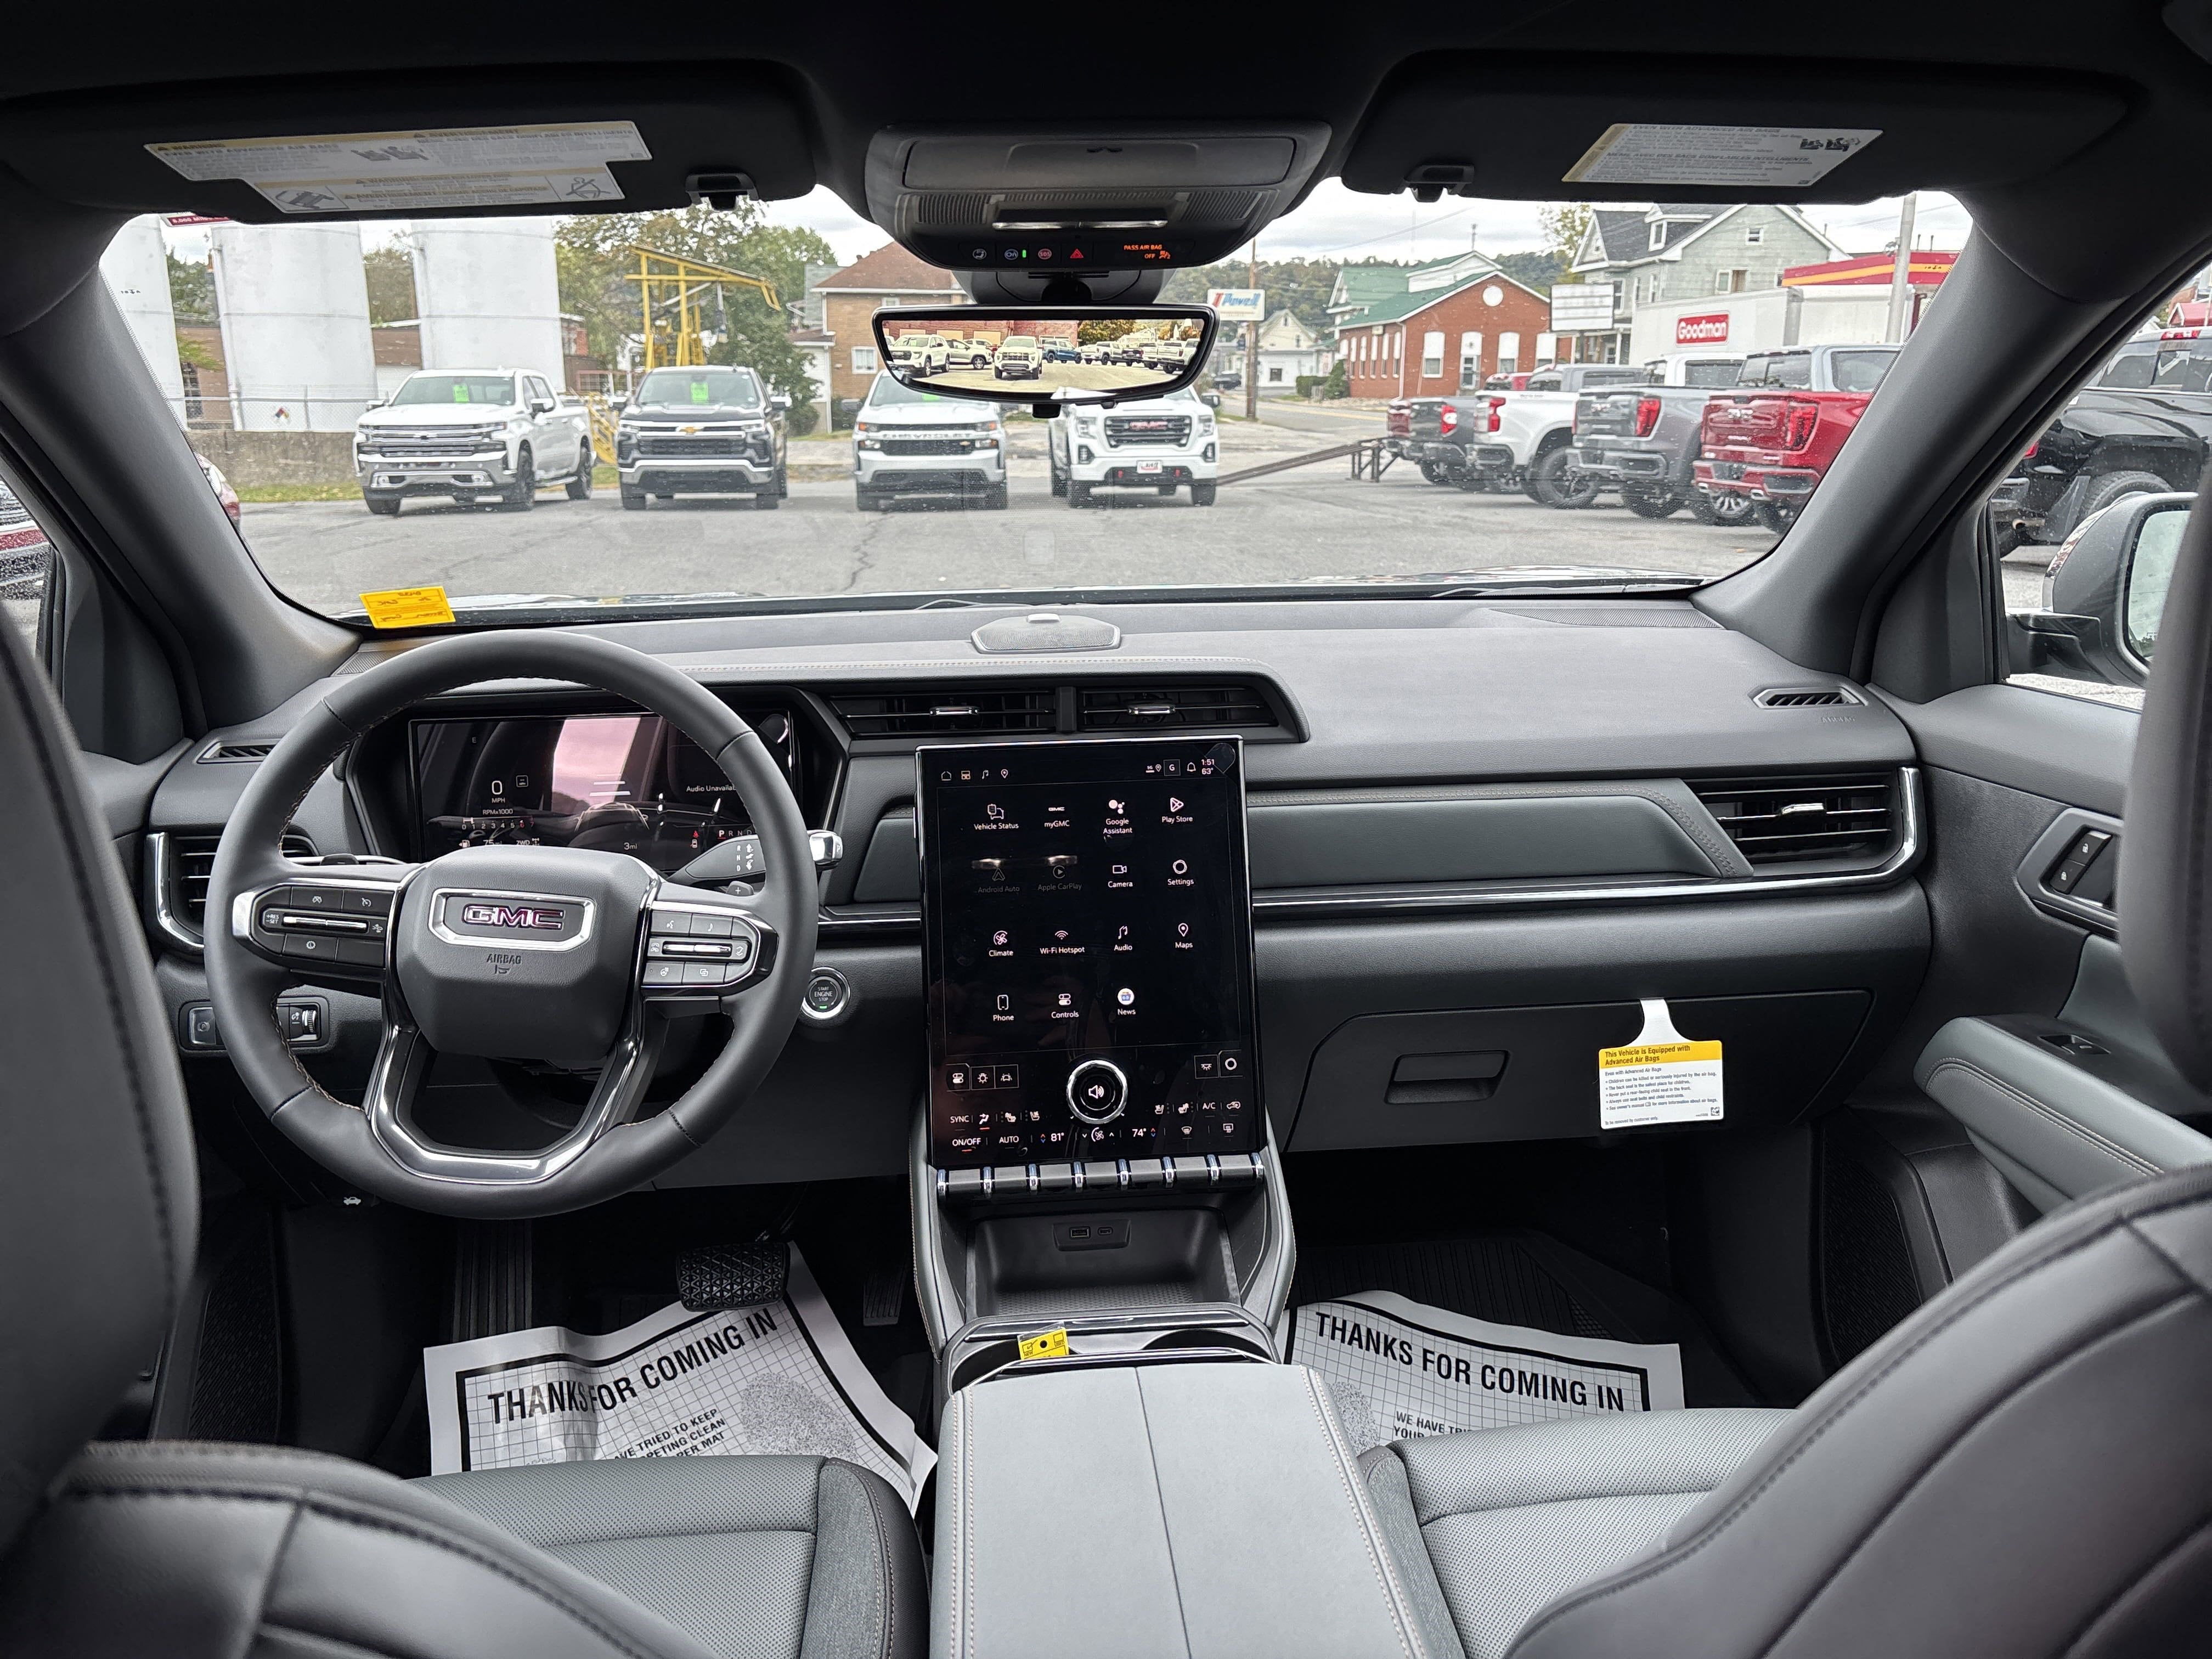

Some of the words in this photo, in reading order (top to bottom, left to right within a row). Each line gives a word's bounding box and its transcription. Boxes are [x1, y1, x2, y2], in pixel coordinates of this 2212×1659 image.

[1679, 319, 1726, 340] Goodman
[492, 781, 503, 795] 0
[1044, 820, 1070, 829] myGMC
[1105, 818, 1129, 827] Google
[1161, 816, 1175, 824] Play
[1167, 878, 1194, 887] Settings
[978, 885, 1004, 893] Android
[1037, 884, 1057, 893] Apple
[1058, 882, 1082, 891] CarPlay
[462, 904, 565, 930] GMC
[1114, 943, 1132, 951] Audio
[1175, 941, 1193, 950] Maps
[989, 949, 1014, 957] Climate
[1040, 946, 1058, 955] Wi-Fi
[1059, 946, 1085, 955] Hotspot
[486, 953, 522, 966] AIRBAG
[1051, 1011, 1079, 1019] Controls
[1117, 1008, 1136, 1016] News
[1648, 1046, 1675, 1055] Equipped
[1605, 1057, 1633, 1065] Advanced
[1051, 1132, 1065, 1142] 81°
[1132, 1128, 1147, 1137] 74°
[952, 1137, 981, 1146] ON/OFF
[998, 1136, 1019, 1144] AUTO
[488, 1379, 589, 1425] THANKS
[587, 1374, 637, 1413] FOR
[639, 1323, 745, 1390] COMING
[746, 1307, 778, 1341] IN
[1316, 1311, 1414, 1366] THANKS
[1422, 1347, 1471, 1386] FOR
[1481, 1364, 1587, 1407] COMING
[1597, 1385, 1624, 1412] IN
[1396, 1410, 1414, 1425] WE
[1416, 1417, 1445, 1434] HAVE
[636, 1430, 671, 1452] TRIED
[672, 1423, 689, 1435] TO
[690, 1408, 718, 1427] KEEP
[689, 1418, 726, 1441] CLEAN
[701, 1431, 725, 1448] MAT
